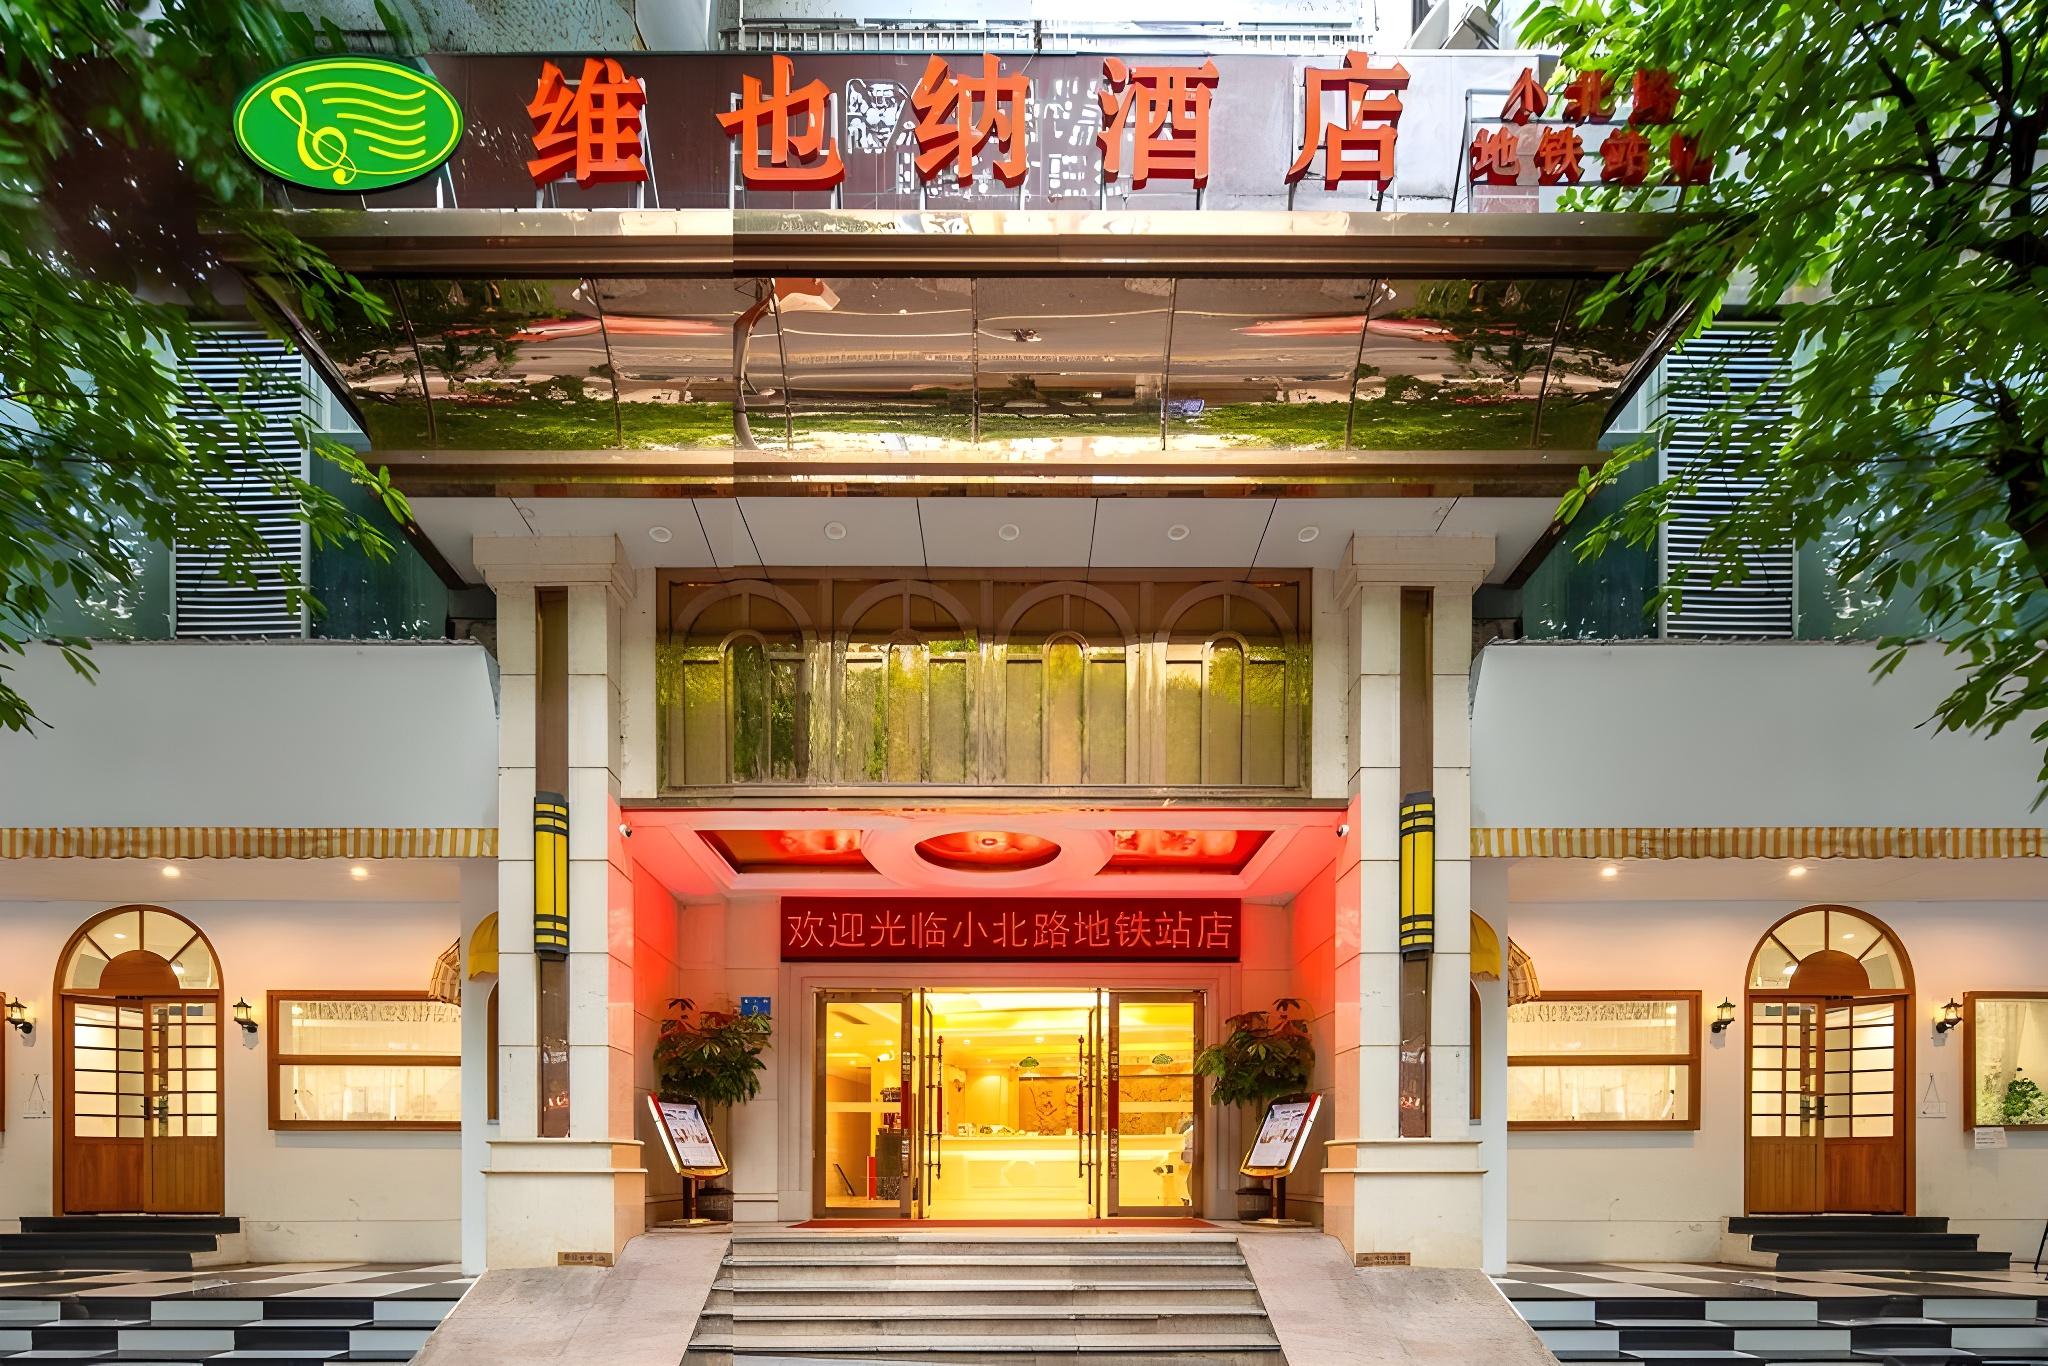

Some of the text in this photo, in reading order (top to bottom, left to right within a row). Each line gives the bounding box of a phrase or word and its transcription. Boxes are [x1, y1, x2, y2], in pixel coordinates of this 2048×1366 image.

[526, 51, 1411, 191] 维也纳酒店
[786, 909, 1234, 949] 欢迎光临小北路地铁站店
